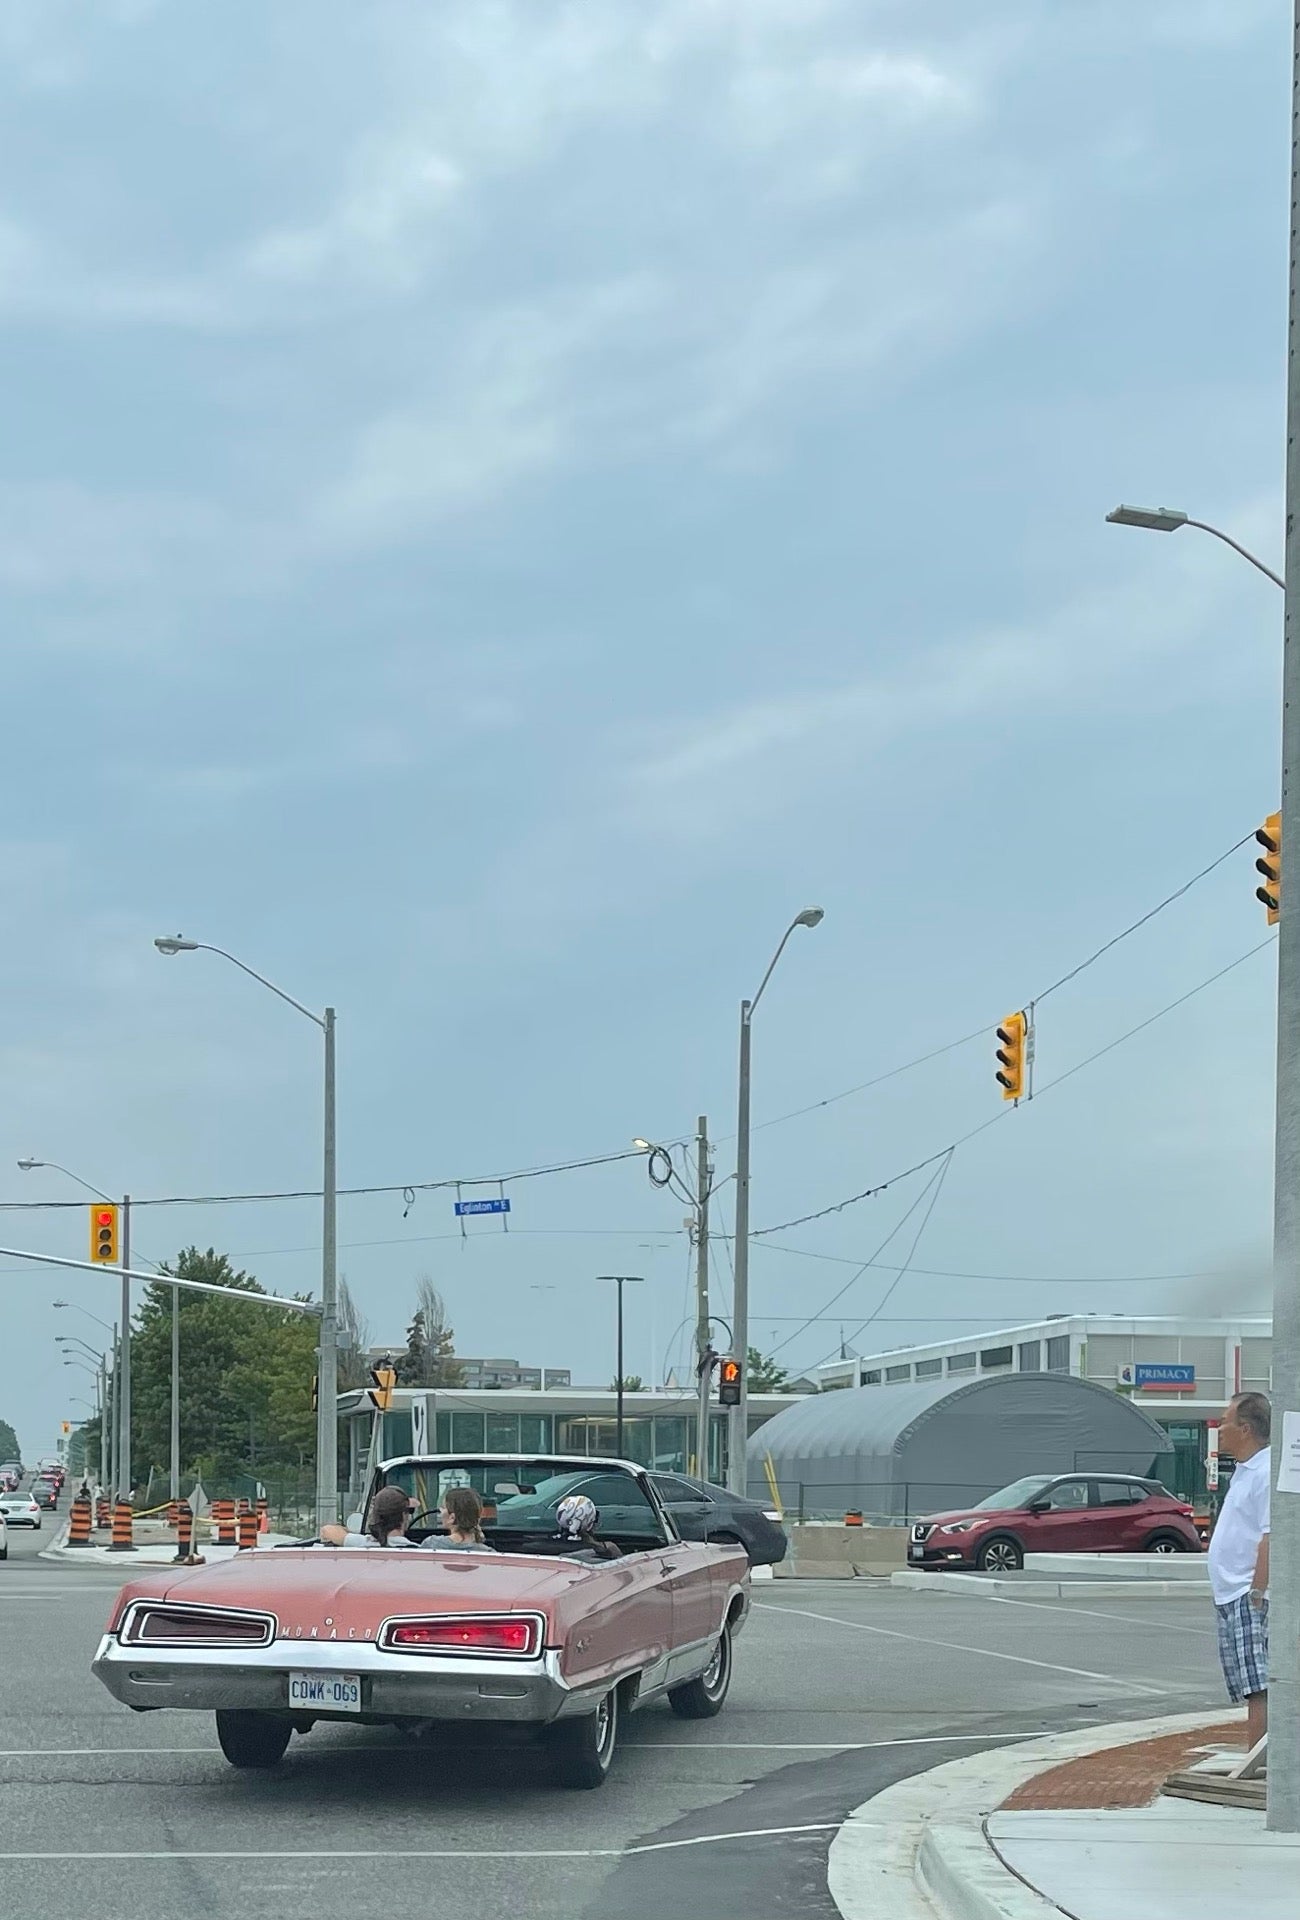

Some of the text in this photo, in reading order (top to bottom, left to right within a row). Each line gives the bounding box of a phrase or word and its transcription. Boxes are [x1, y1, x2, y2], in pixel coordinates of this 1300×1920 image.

[459, 1202, 492, 1214] Eglinton
[500, 1200, 507, 1210] E
[1138, 1368, 1190, 1379] PRIMACY
[281, 1626, 372, 1639] MONACO
[333, 1683, 358, 1702] 069
